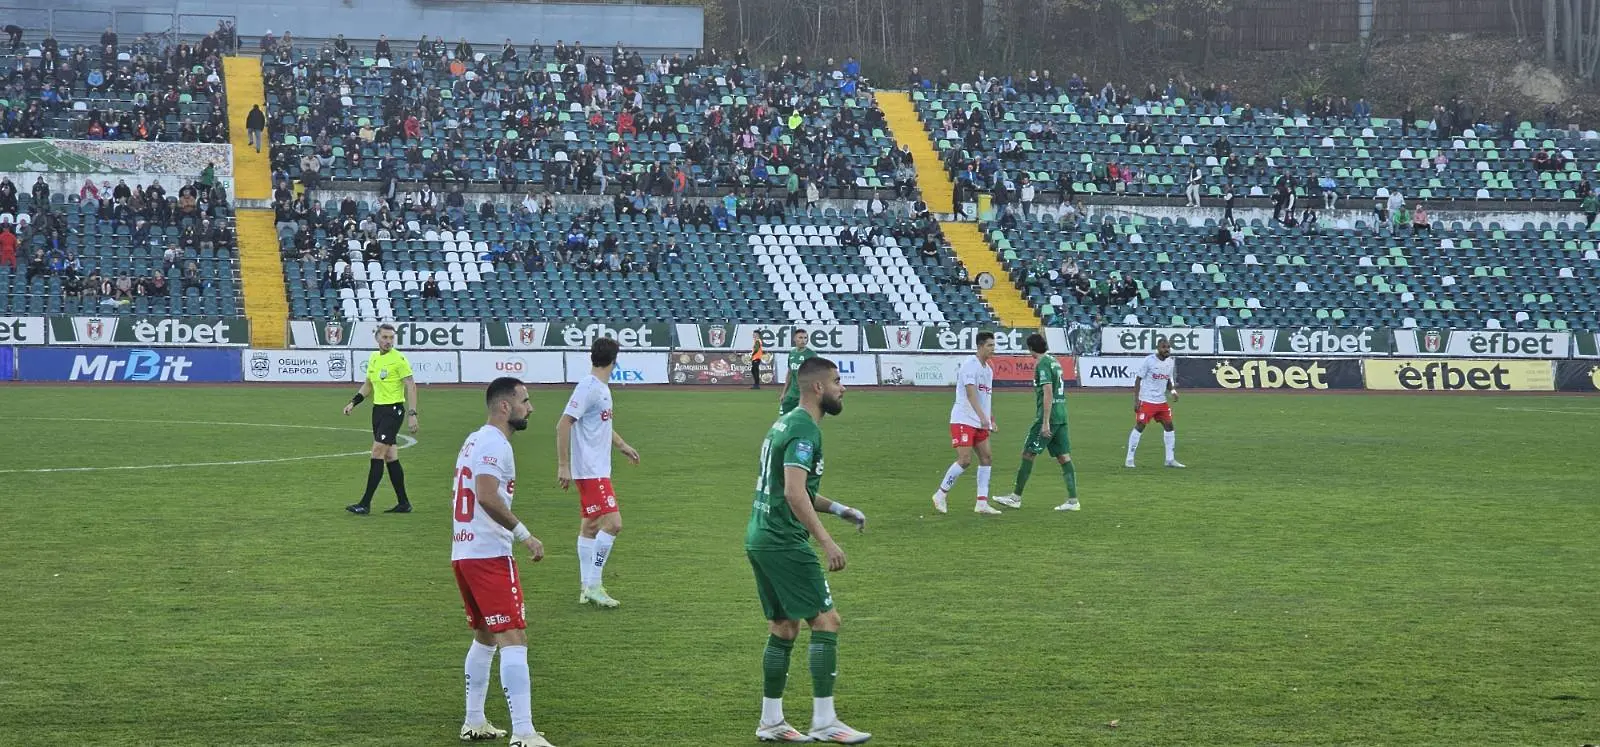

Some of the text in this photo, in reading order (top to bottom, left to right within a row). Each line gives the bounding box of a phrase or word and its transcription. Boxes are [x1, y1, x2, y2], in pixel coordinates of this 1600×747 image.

[133, 319, 230, 343] efbet
[393, 323, 464, 346] fbet
[1290, 330, 1373, 353] efbet
[1469, 333, 1554, 355] efbet
[69, 349, 192, 381] MrBit
[277, 358, 318, 366] ОБЩИНА
[277, 367, 319, 375] ГАБРОВО
[495, 361, 523, 372] UCO
[837, 361, 855, 374] LI
[1015, 362, 1035, 371] MAZ
[610, 370, 644, 381] MEX
[1215, 360, 1329, 390] efbet
[1397, 361, 1511, 391] efbet
